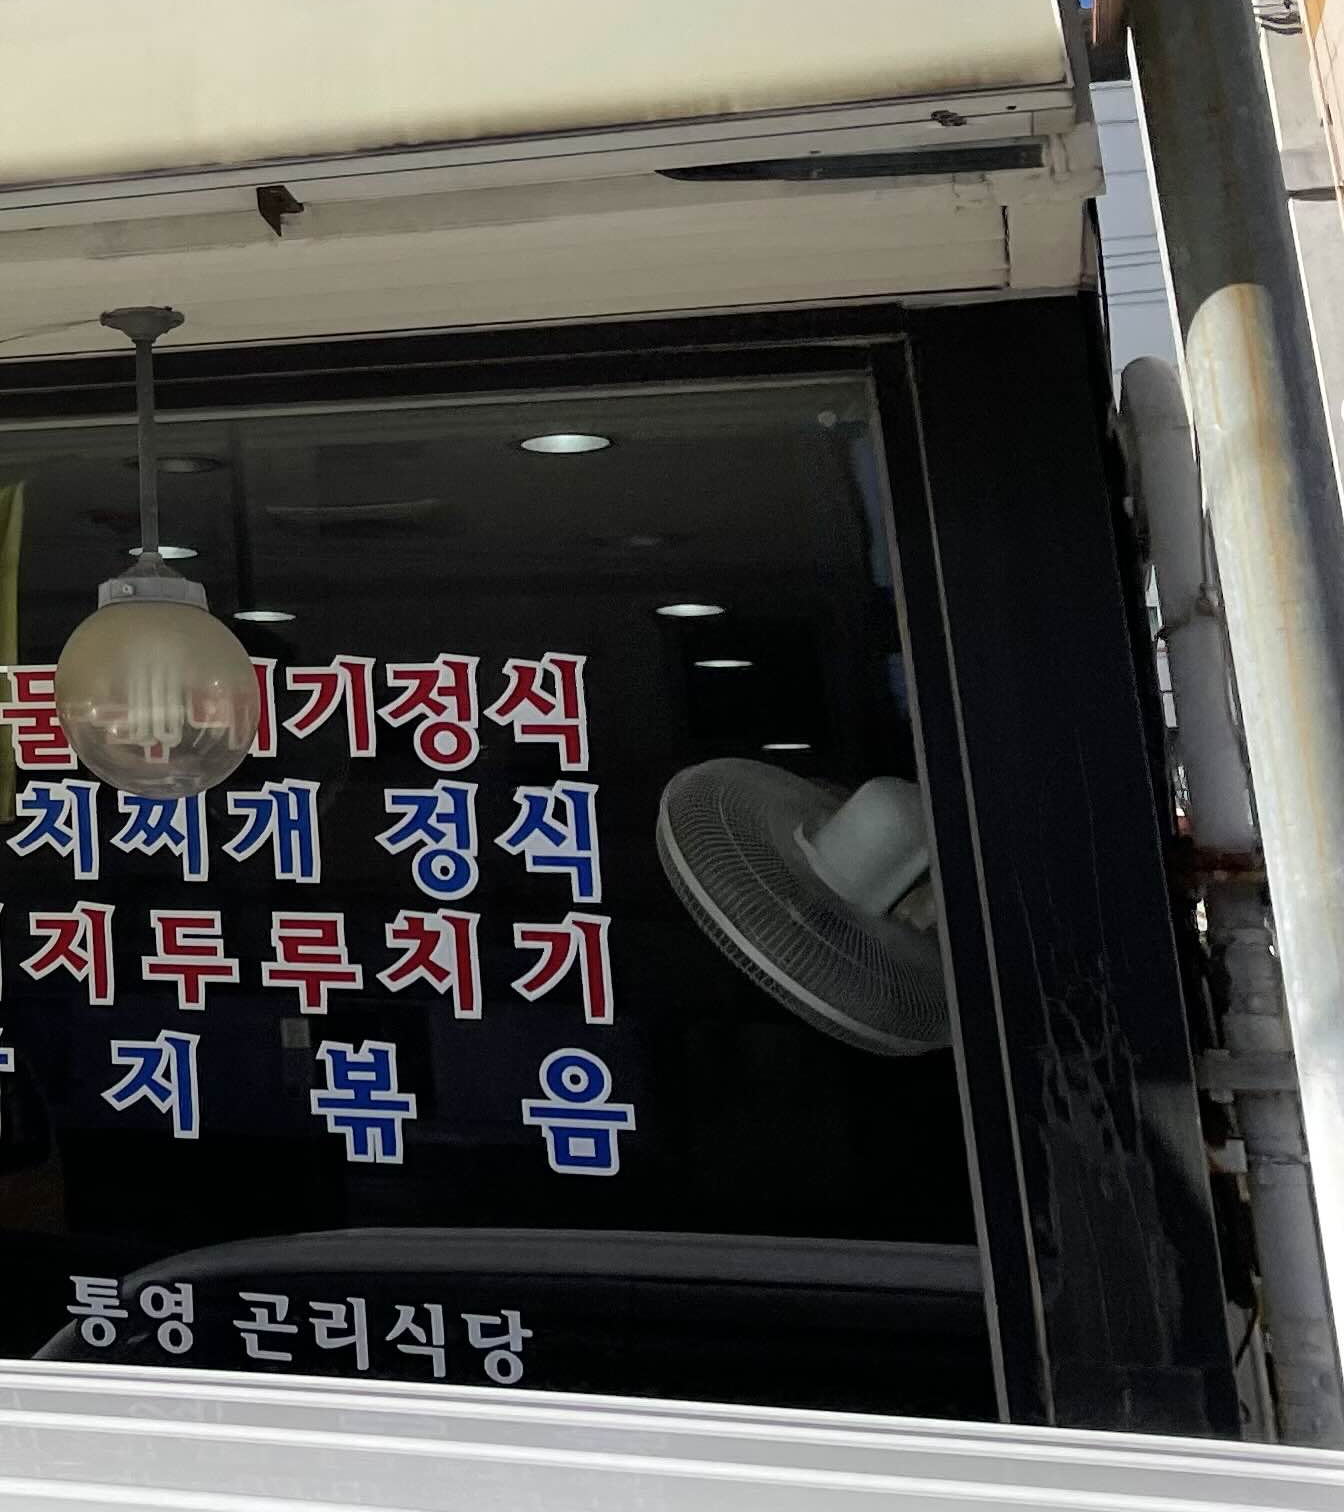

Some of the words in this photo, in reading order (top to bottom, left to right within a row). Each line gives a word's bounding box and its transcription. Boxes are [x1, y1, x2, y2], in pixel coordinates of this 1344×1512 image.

[377, 779, 603, 904] 정식
[67, 1275, 196, 1355] 통영
[232, 1291, 533, 1385] 곤리식당
